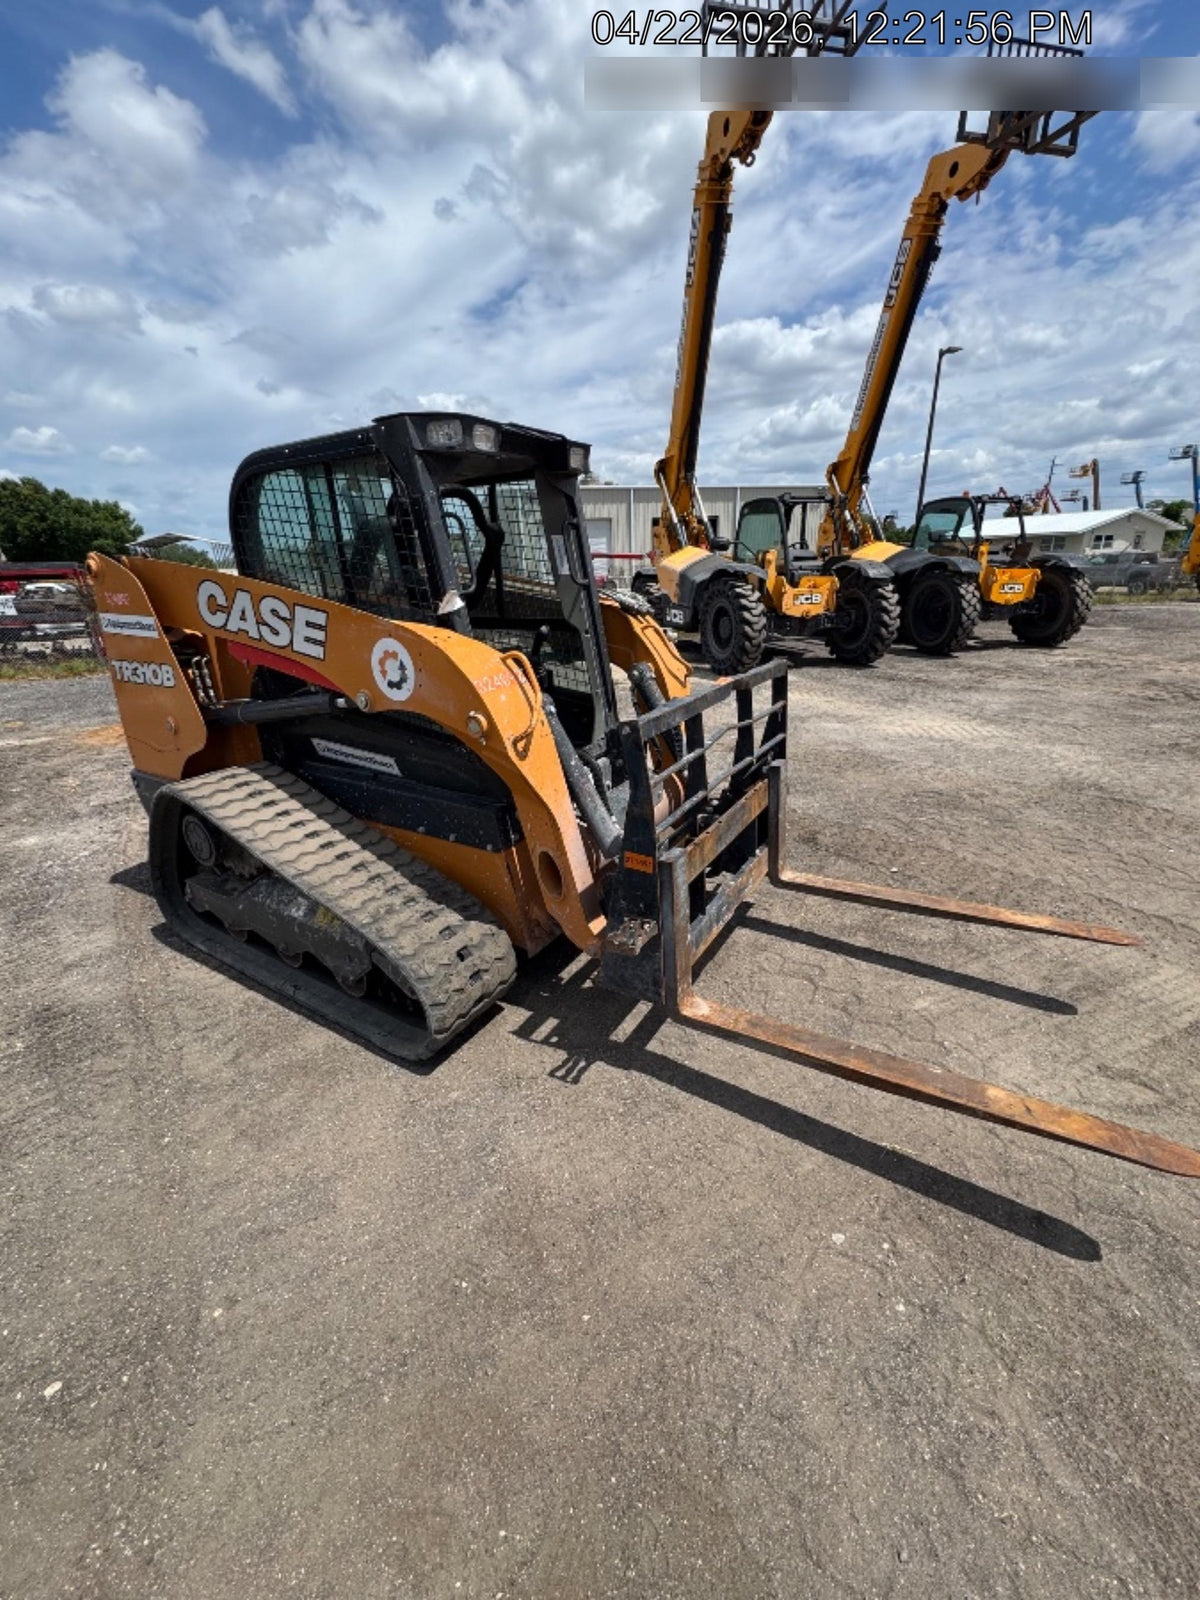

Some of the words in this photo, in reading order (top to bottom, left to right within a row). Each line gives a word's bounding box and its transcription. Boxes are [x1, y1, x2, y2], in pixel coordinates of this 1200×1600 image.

[794, 593, 823, 606] JCB
[197, 579, 329, 661] CASE
[666, 609, 684, 624] JCB
[111, 659, 176, 687] TR310B
